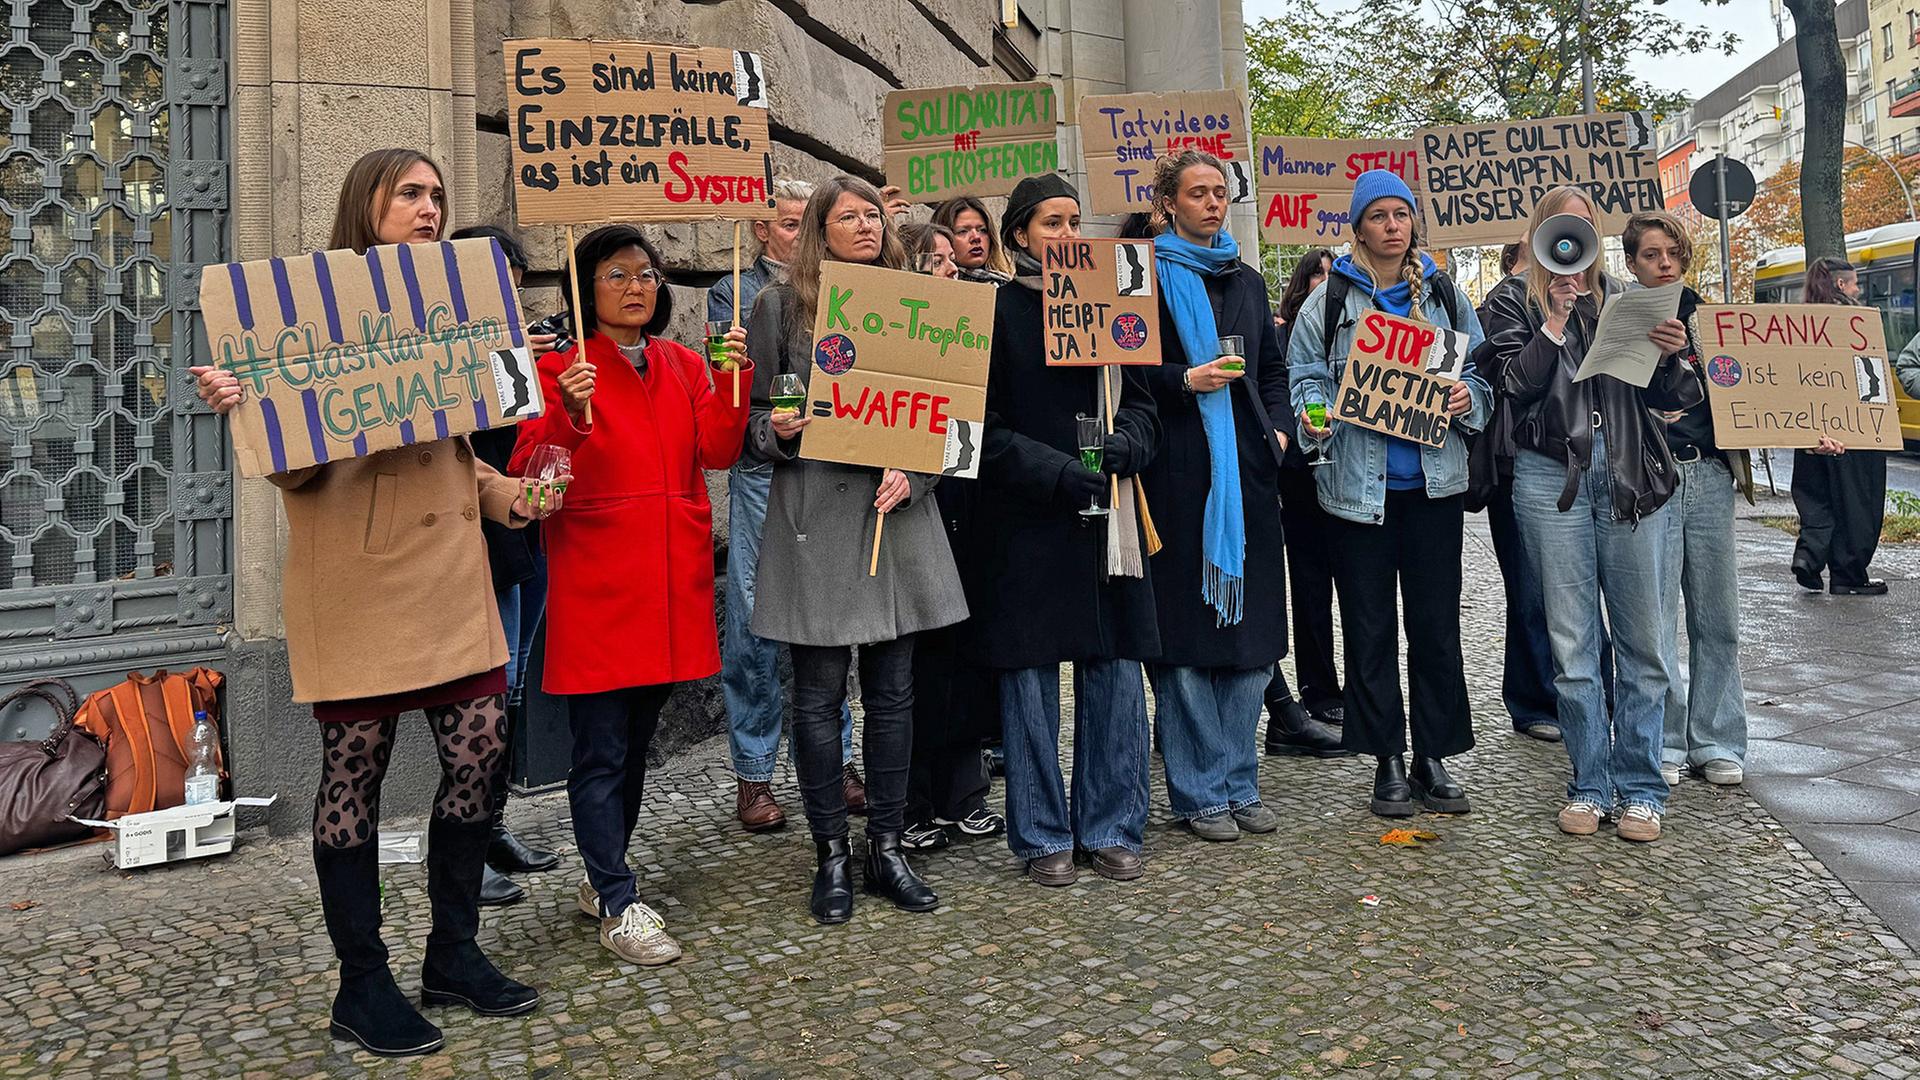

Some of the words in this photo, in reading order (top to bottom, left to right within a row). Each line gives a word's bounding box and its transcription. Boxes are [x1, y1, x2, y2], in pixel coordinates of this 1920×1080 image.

[515, 47, 567, 96] Es
[592, 51, 656, 94] sind
[670, 52, 736, 97] keine
[517, 104, 751, 153] EINZELFÄLLE,
[896, 87, 1055, 141] SOLIDARITÄT
[1099, 107, 1230, 139] Tatvideos
[954, 130, 981, 151] MIT
[1116, 140, 1157, 163] sind
[1263, 144, 1337, 177] Männer
[1423, 129, 1497, 164] RAPE
[1506, 119, 1627, 154] CULTURE
[521, 161, 560, 192] es
[571, 149, 613, 186] ist
[620, 154, 660, 184] ein
[908, 142, 1058, 195] BETROFFENEN
[1589, 150, 1655, 180] MIT-
[1264, 193, 1319, 229] AUF
[1316, 209, 1351, 237] gege
[1431, 187, 1529, 227] WISSER
[1046, 243, 1096, 270] NUR
[1046, 273, 1078, 299] JA
[1357, 313, 1435, 368] STOP
[1715, 311, 1834, 348] FRANK
[1352, 359, 1454, 414] VICTIM
[1746, 361, 1778, 386] ist
[1798, 362, 1848, 390] kein
[1340, 387, 1449, 445] BLAMING
